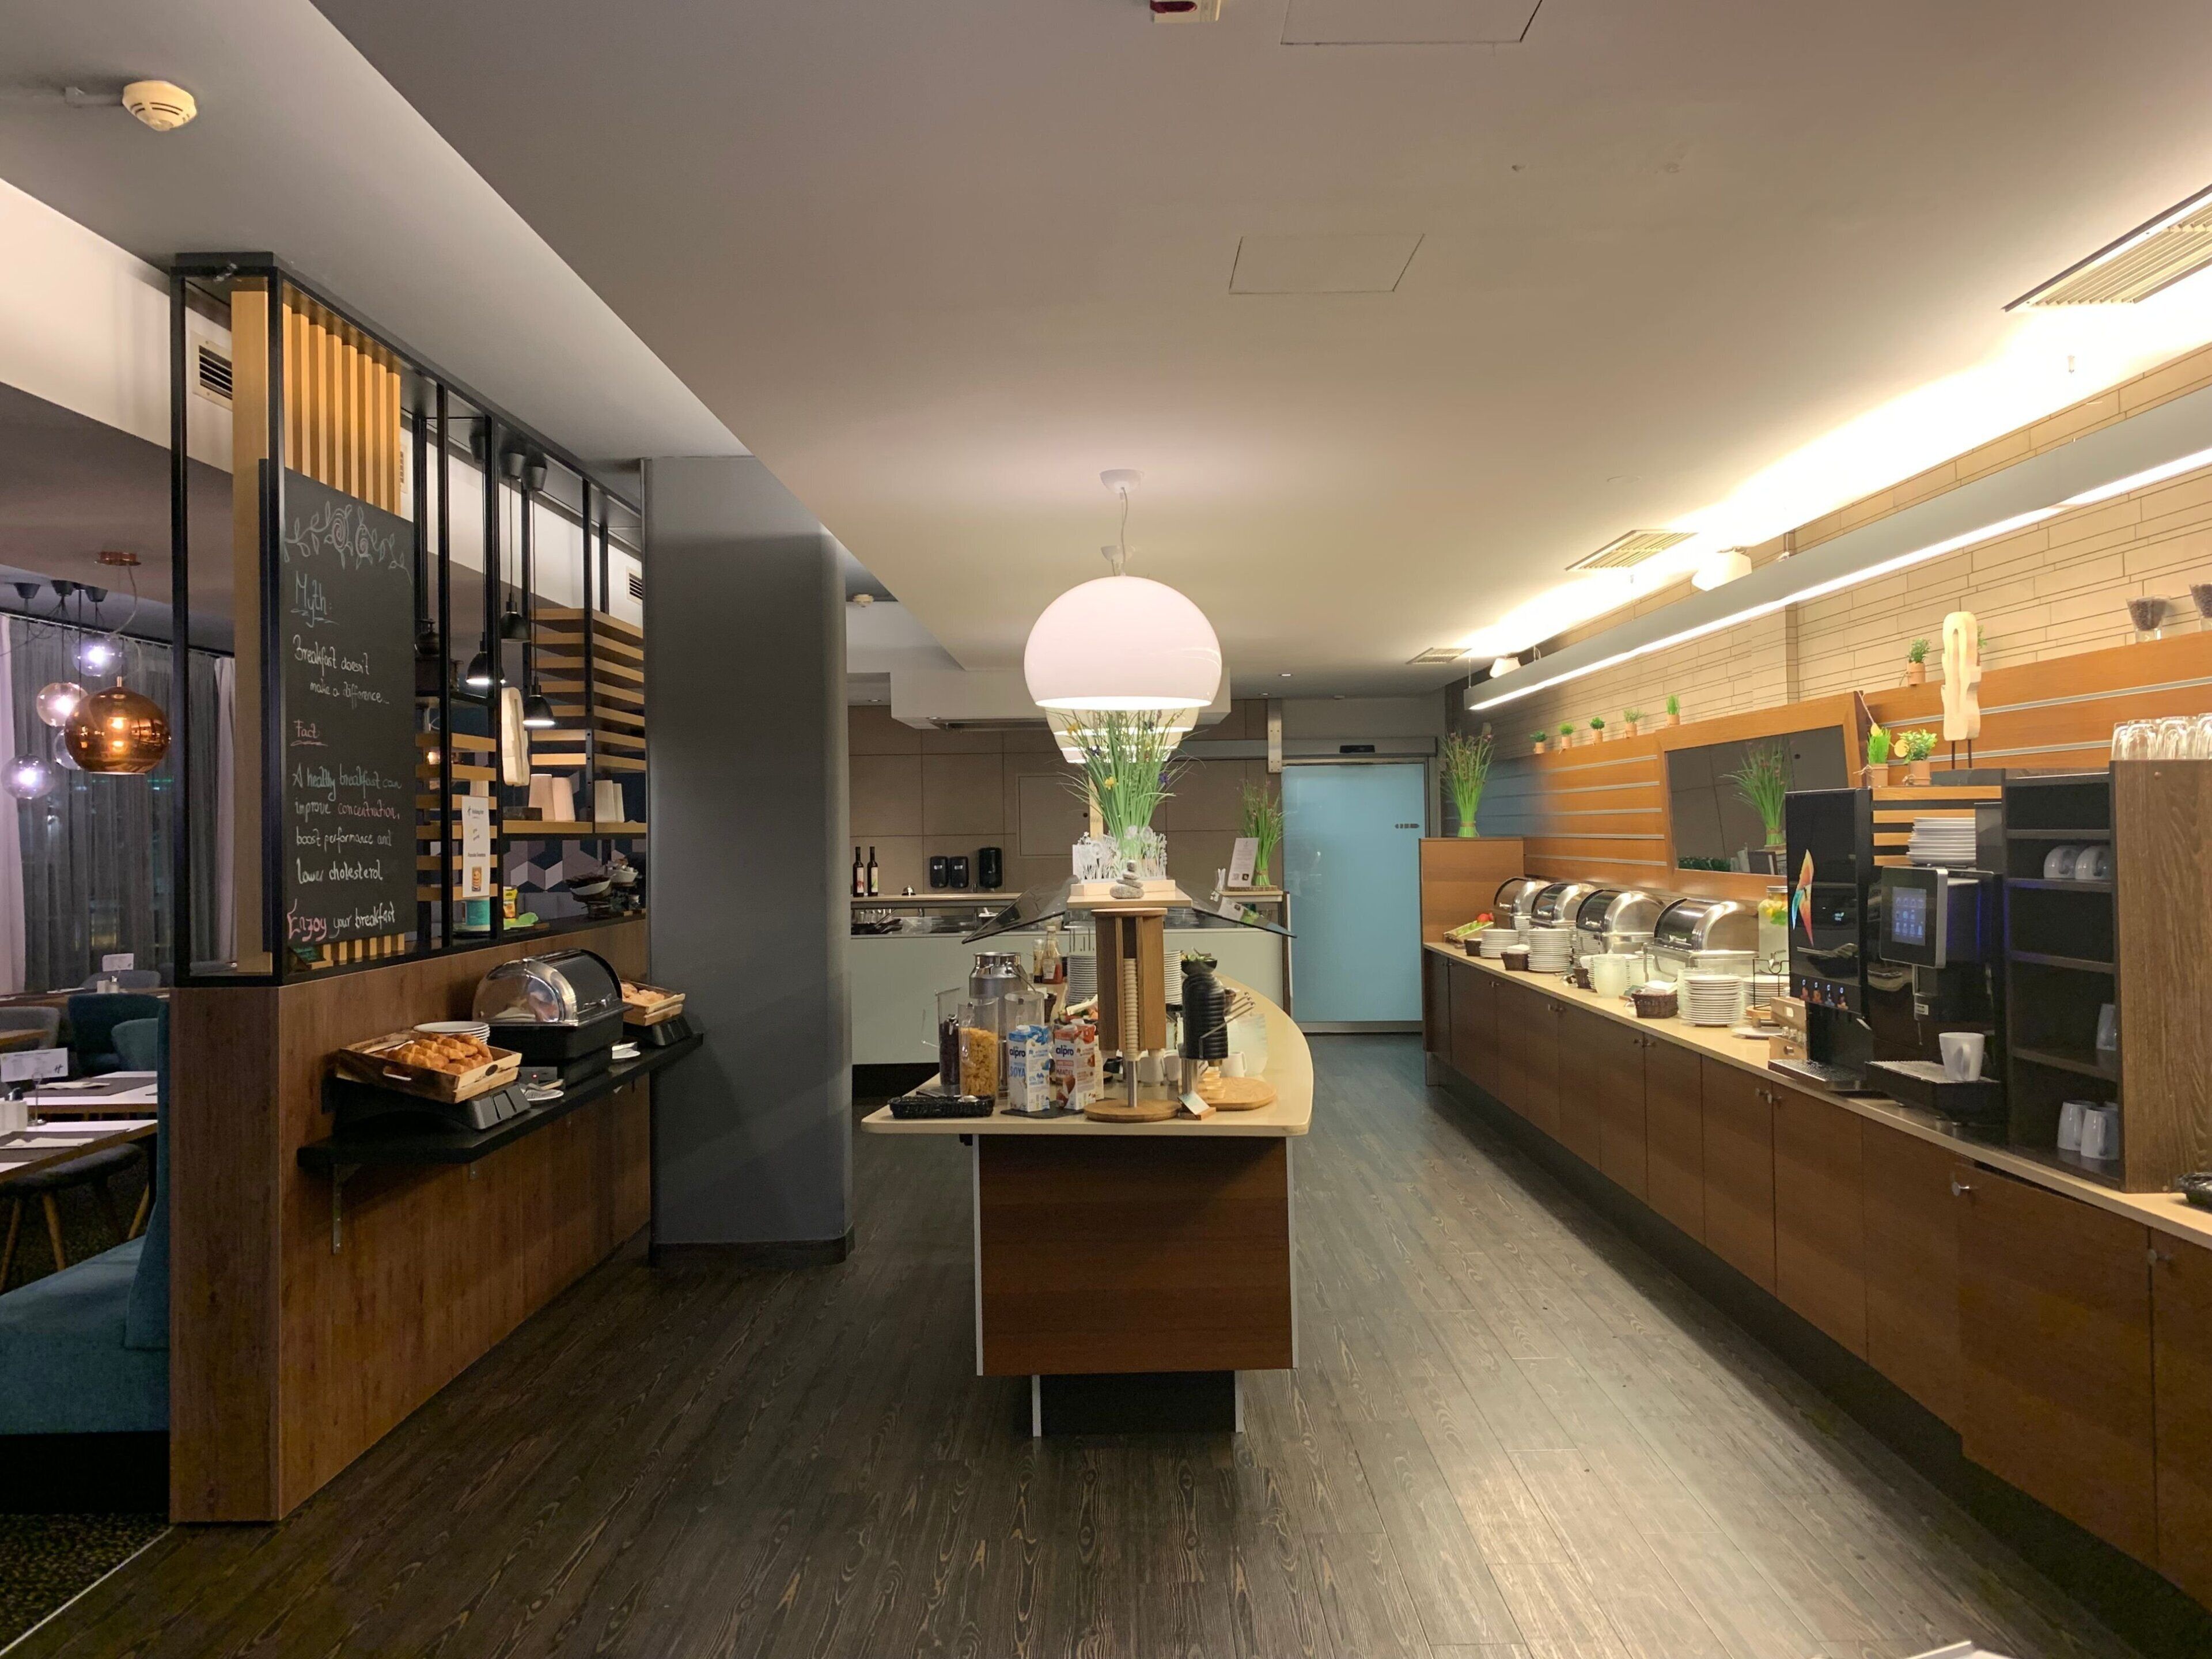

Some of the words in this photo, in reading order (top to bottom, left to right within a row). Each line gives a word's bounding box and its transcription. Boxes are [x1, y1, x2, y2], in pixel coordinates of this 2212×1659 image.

[296, 570, 332, 628] Myth:
[293, 634, 337, 677] Breakfast
[310, 678, 331, 695] make
[332, 687, 340, 697] a
[292, 763, 304, 789] A
[306, 766, 336, 802] healthy
[339, 763, 381, 799] breakfast
[382, 778, 402, 789] can
[295, 797, 331, 823] improve
[296, 825, 321, 847] boost
[324, 826, 373, 854] performance
[377, 829, 392, 847] and
[328, 858, 383, 881] cholesterol
[328, 915, 353, 939] your
[355, 900, 395, 930] breakfast
[1009, 1046, 1026, 1058] alpro
[1055, 1044, 1074, 1057] alpro
[1010, 1066, 1026, 1077] SOYA
